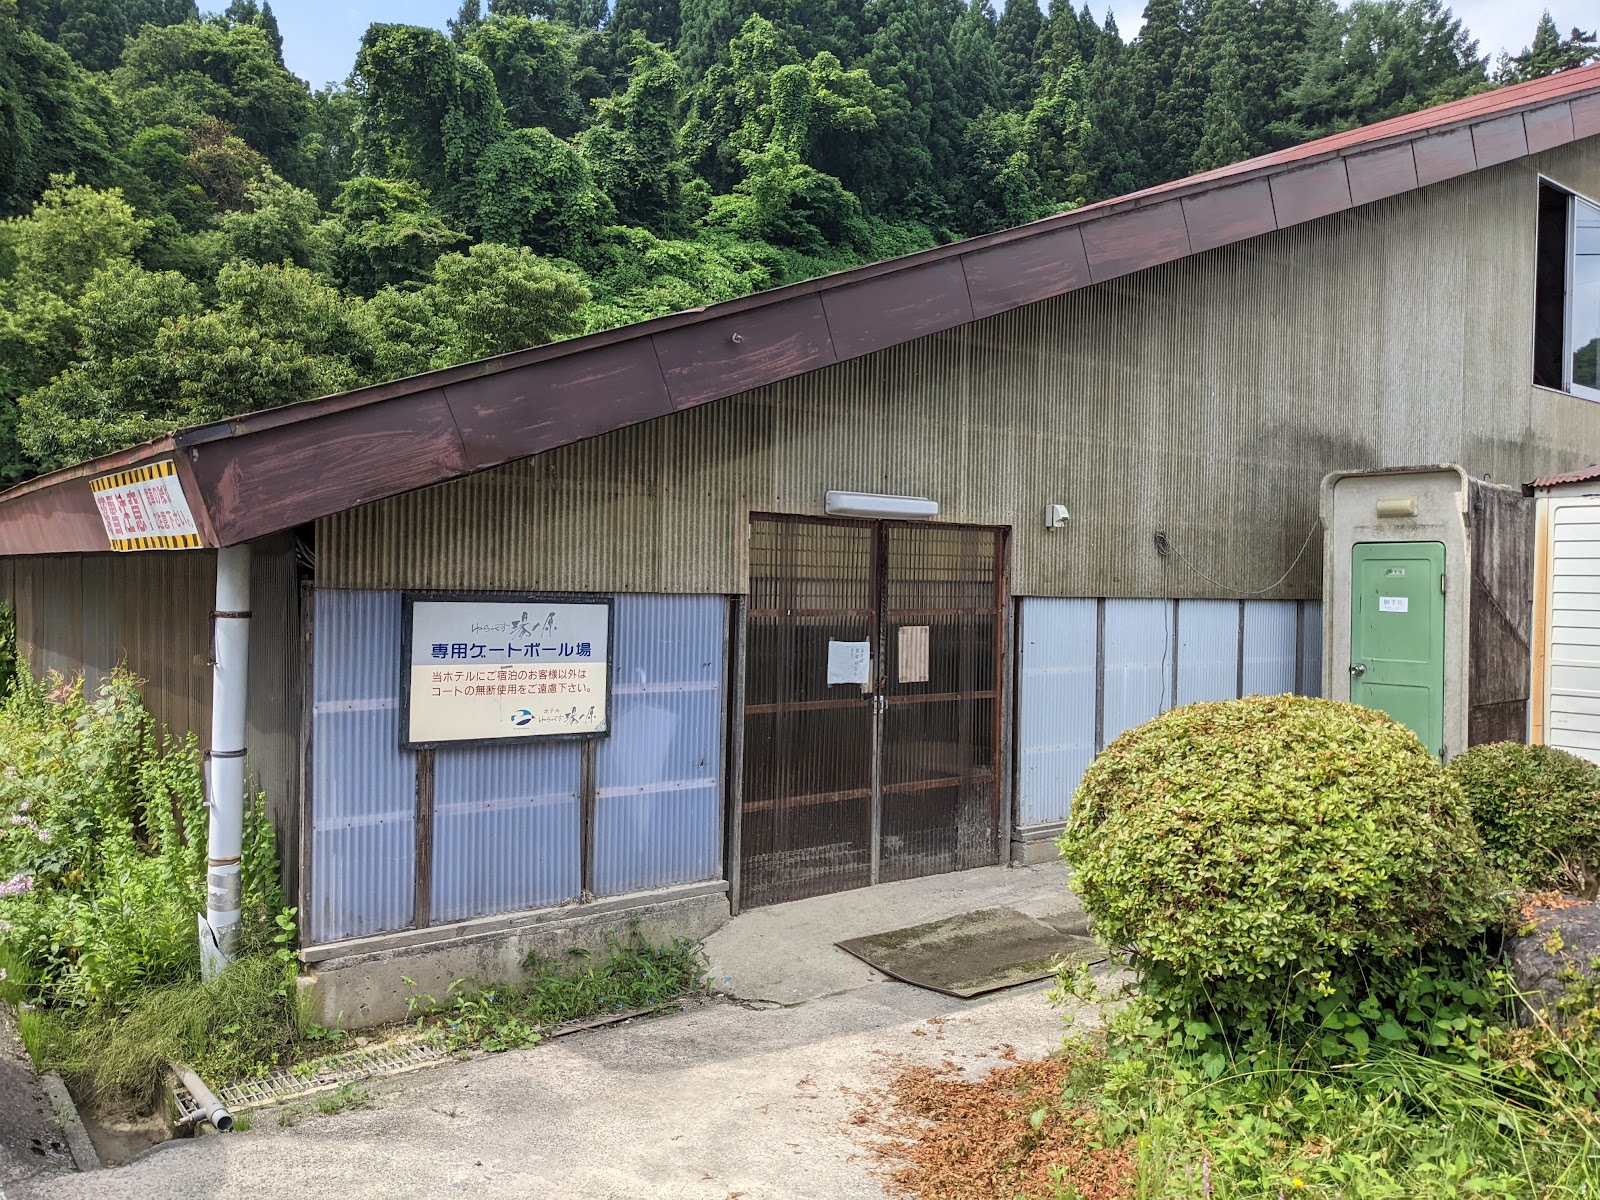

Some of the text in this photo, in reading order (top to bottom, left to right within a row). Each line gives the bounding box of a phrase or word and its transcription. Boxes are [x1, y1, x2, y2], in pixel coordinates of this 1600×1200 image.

[431, 642, 592, 659] 専用ゲートボール場
[431, 669, 587, 682] 当ホテルにご宿泊のお客様以外は
[431, 683, 592, 697] コートの無断使用をご遠慮下さい。
